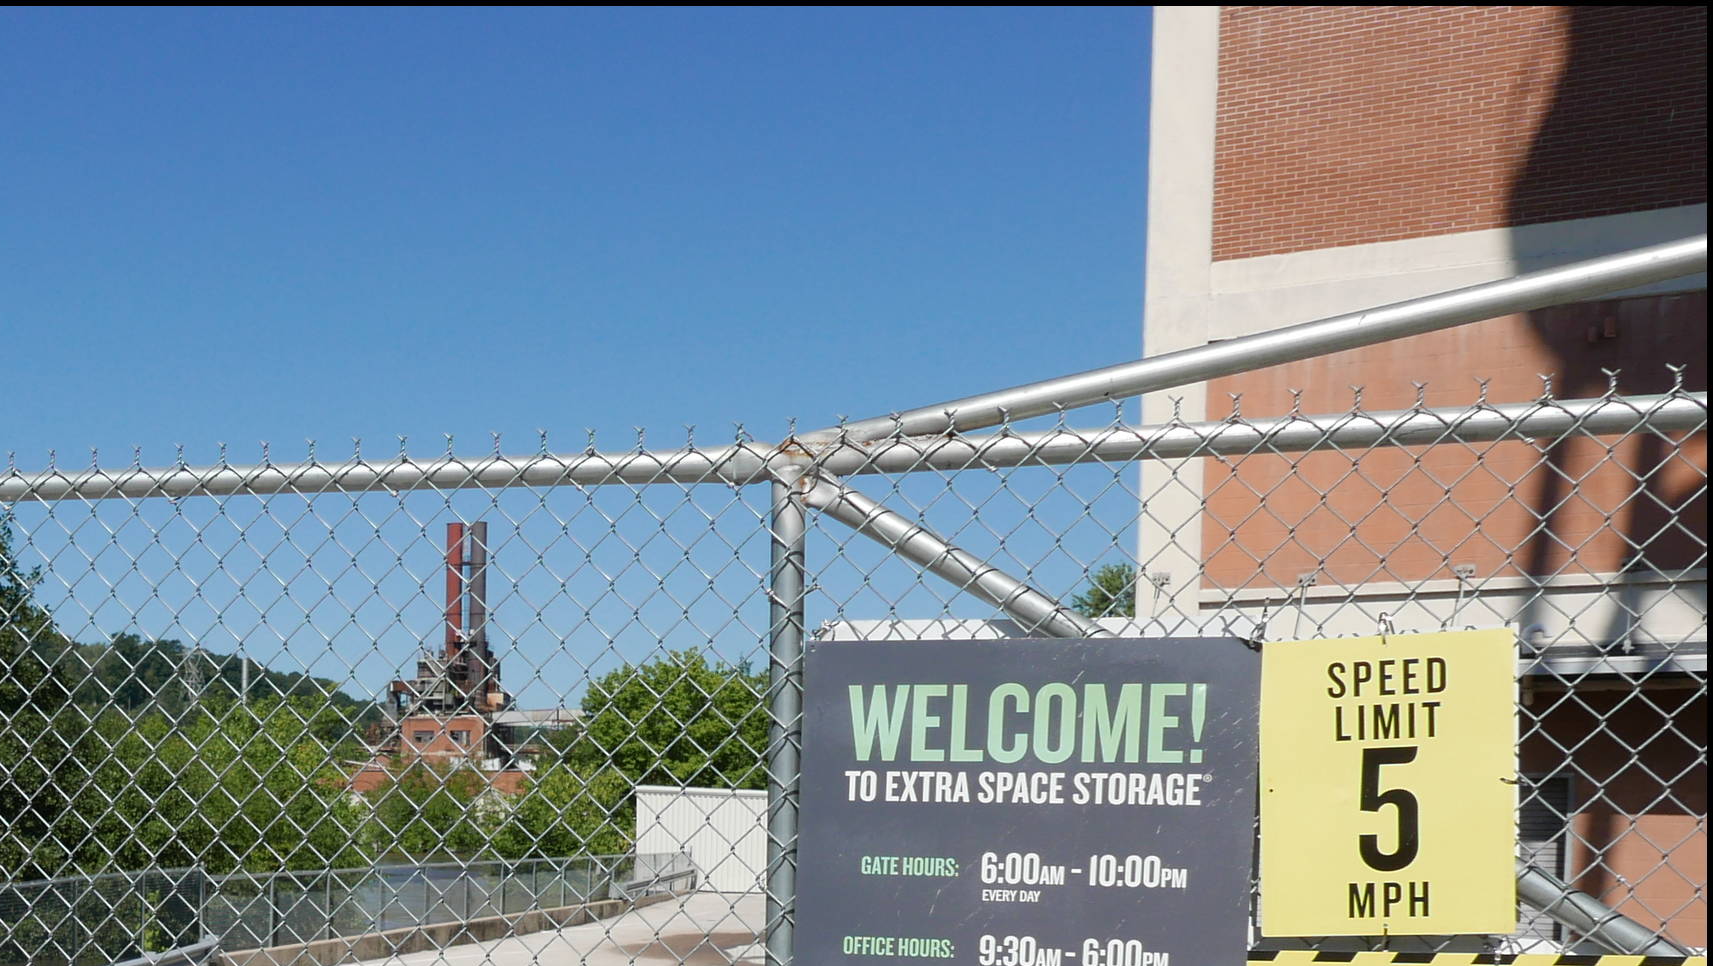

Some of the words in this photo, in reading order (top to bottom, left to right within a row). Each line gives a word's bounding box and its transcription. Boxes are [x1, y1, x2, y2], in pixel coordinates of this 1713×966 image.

[1328, 657, 1446, 698] SPEED
[849, 683, 1207, 763] WELCOME!
[1336, 702, 1440, 741] LIMIT
[845, 770, 877, 801] TO
[885, 771, 970, 802] EXTRA
[978, 772, 1065, 804] SPACE
[1359, 746, 1418, 871] 5
[862, 856, 899, 875] GATE
[903, 857, 959, 876] HOURS:
[981, 852, 1065, 885] 6:00AM
[1089, 855, 1187, 888] 10:00PM
[982, 889, 1017, 902] EVERY
[1019, 890, 1040, 902] DAY
[1349, 882, 1429, 918] MPH
[844, 936, 895, 955] OFFICE
[898, 938, 954, 958] HOURS:
